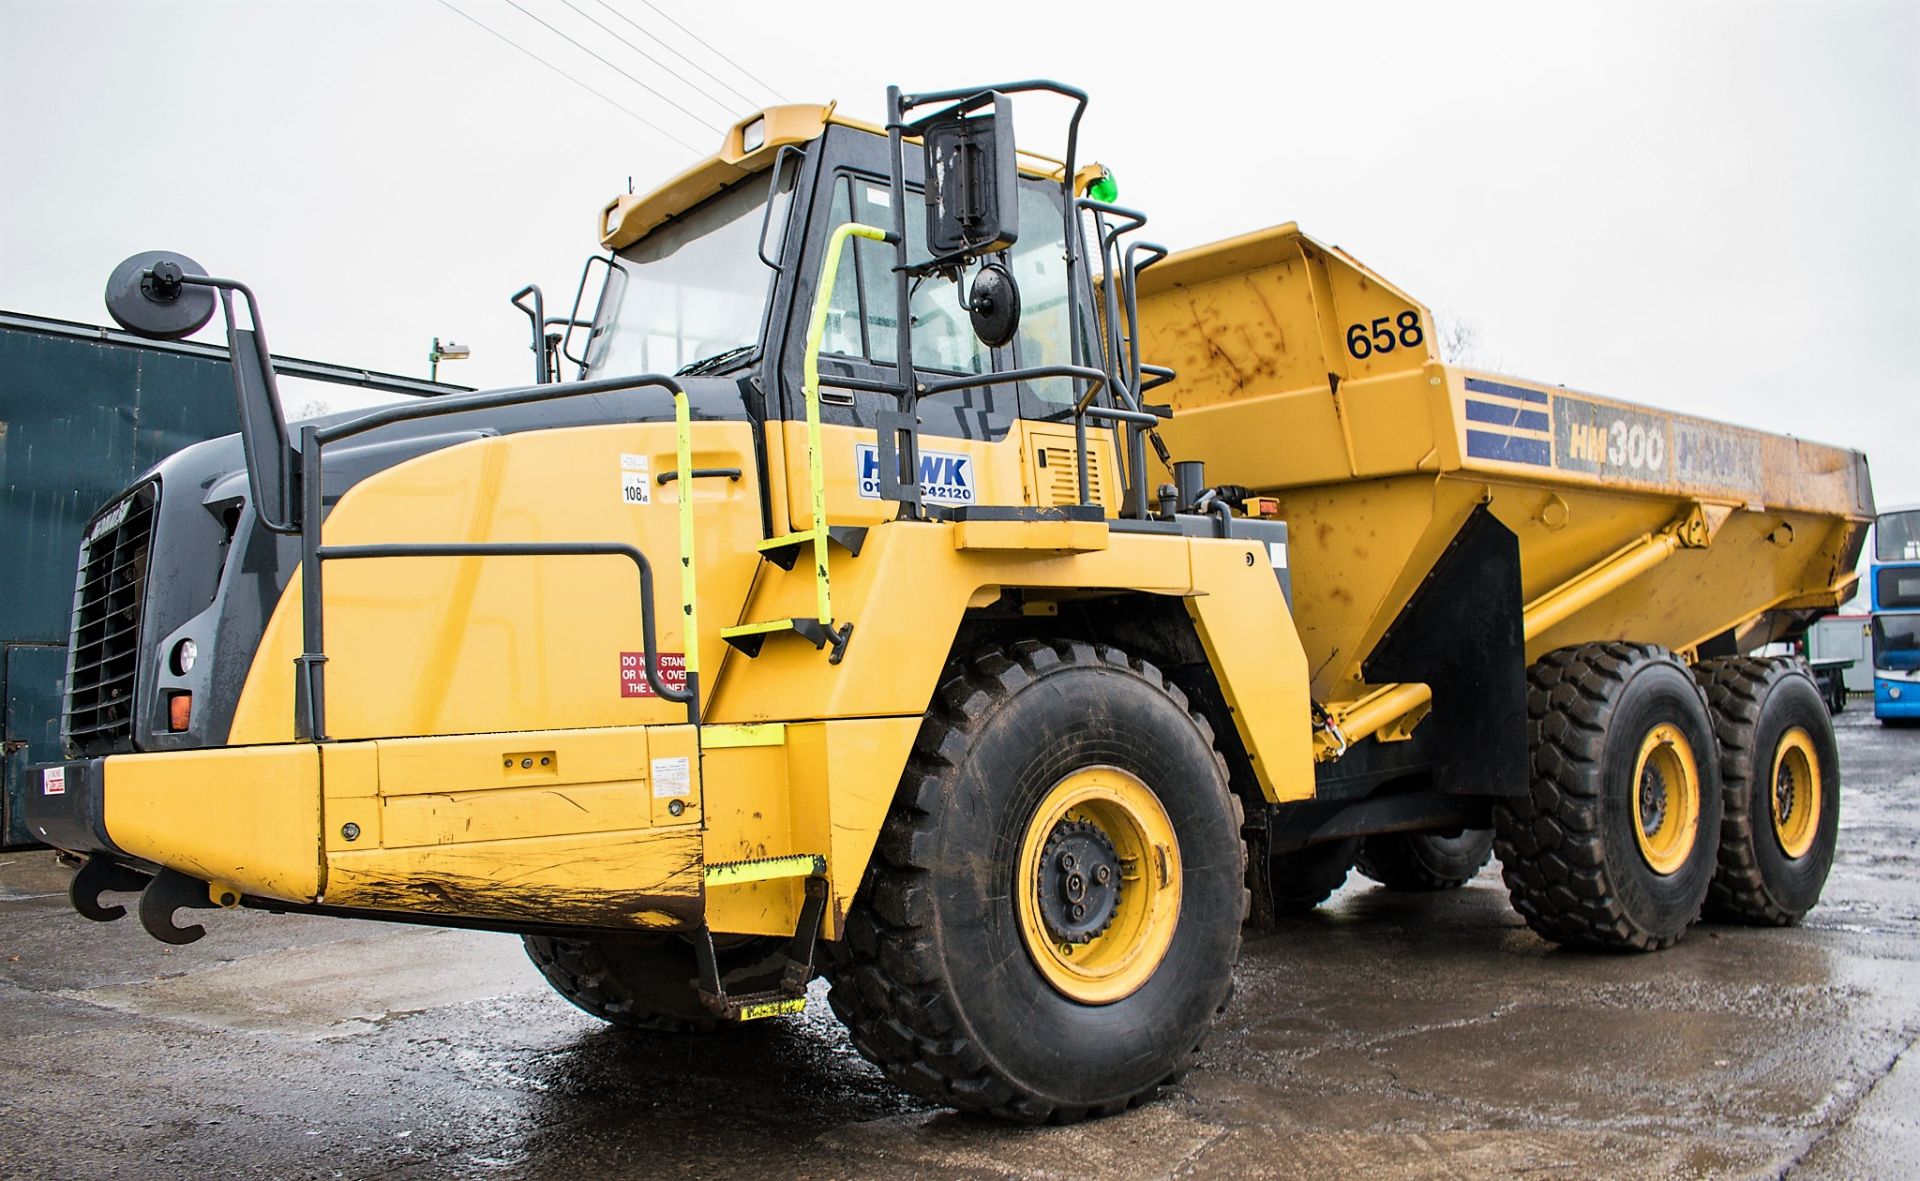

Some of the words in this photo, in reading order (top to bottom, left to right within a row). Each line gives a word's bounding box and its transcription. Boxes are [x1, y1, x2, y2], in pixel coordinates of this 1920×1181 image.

[1347, 310, 1424, 360] 658
[863, 450, 967, 487] HWK
[625, 485, 642, 502] 108
[622, 656, 637, 667] DO
[661, 656, 686, 667] STAN
[622, 670, 636, 680] OR
[639, 670, 665, 680] WK
[628, 683, 647, 693] THE
